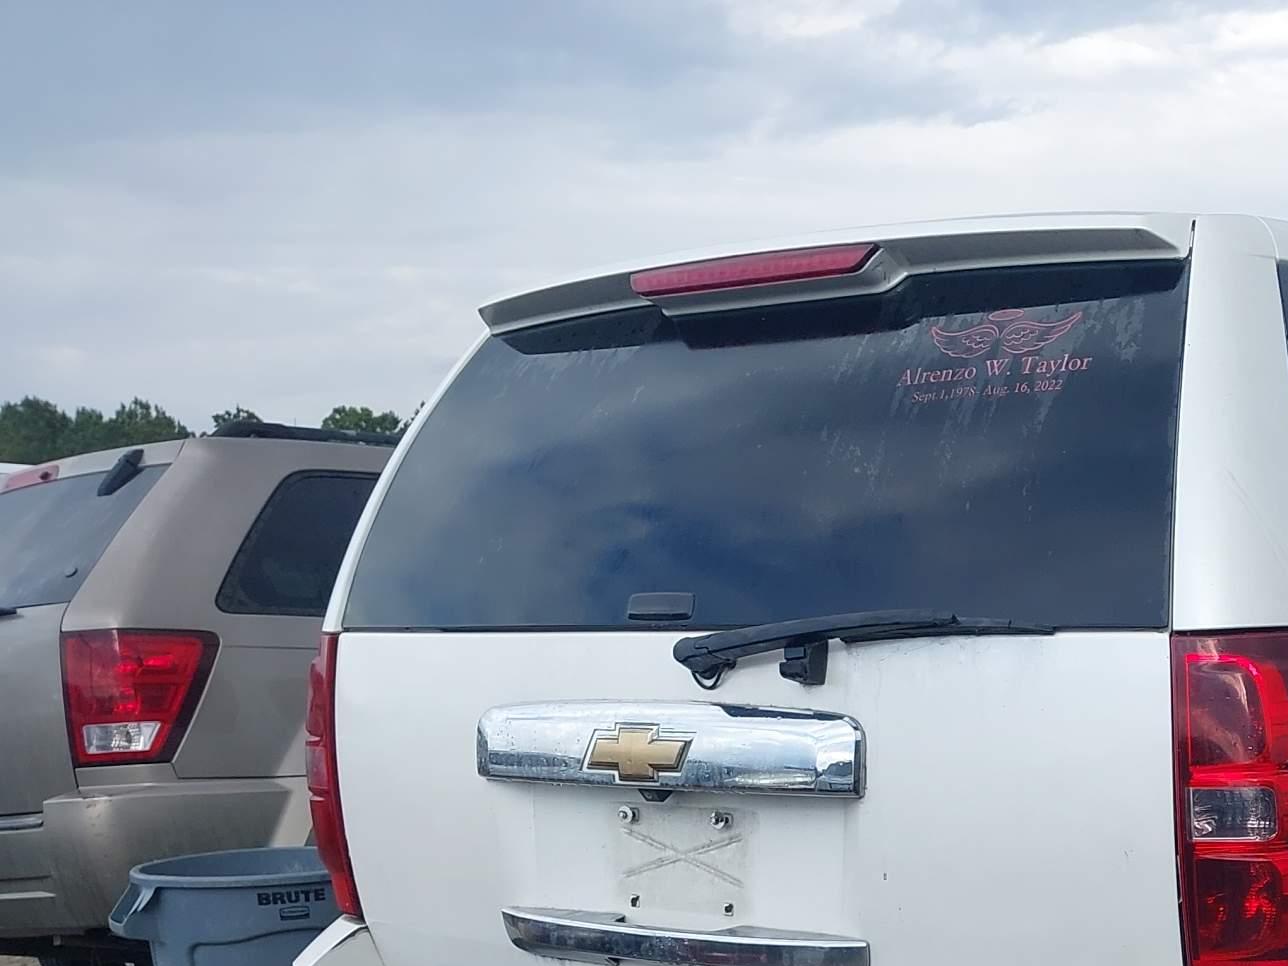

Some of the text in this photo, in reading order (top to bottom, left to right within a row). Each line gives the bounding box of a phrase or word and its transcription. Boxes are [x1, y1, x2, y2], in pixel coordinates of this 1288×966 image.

[985, 359, 1011, 376] W.
[1021, 353, 1093, 377] Taylor
[1014, 382, 1031, 394] 16,
[1034, 379, 1063, 392] 2022
[257, 887, 326, 906] BRUTE
